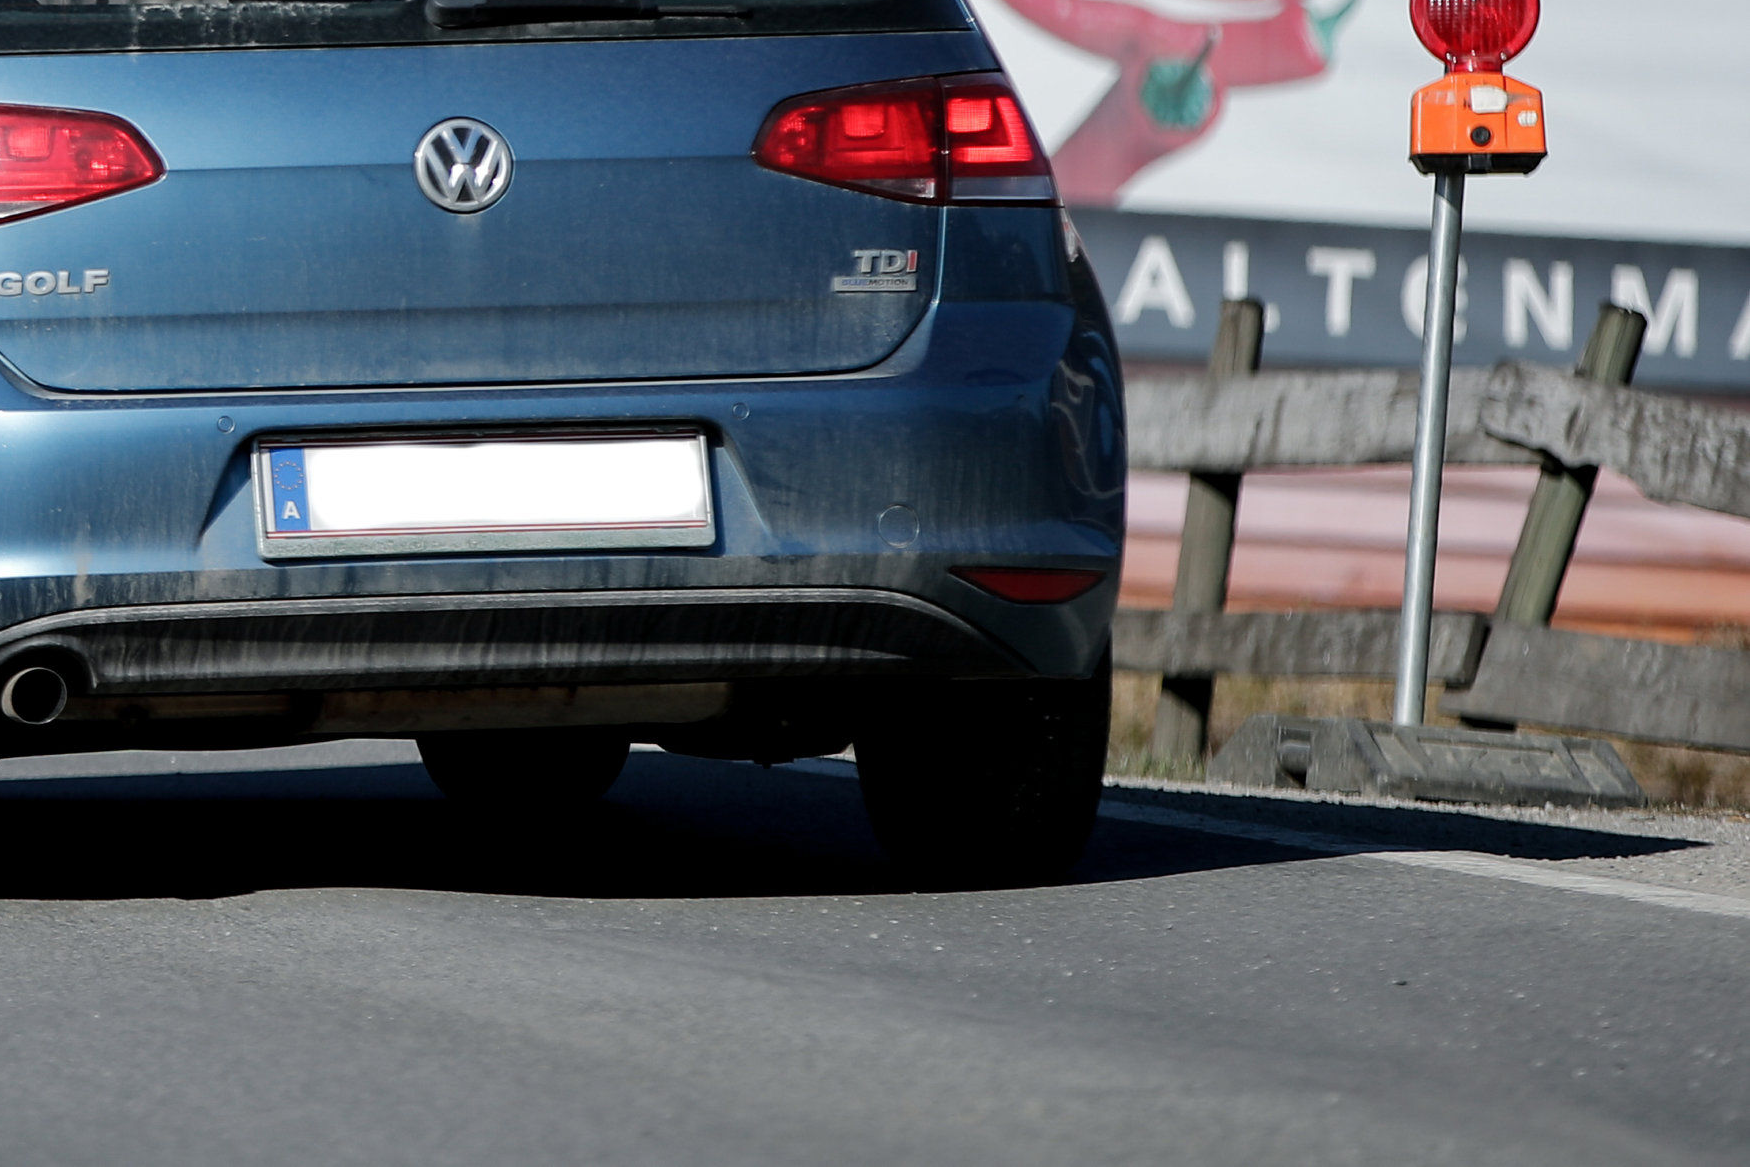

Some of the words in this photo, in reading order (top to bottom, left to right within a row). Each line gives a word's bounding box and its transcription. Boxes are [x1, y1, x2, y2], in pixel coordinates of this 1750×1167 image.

[854, 249, 918, 273] TDI
[1113, 236, 1750, 361] ALTENM
[281, 500, 301, 520] A
